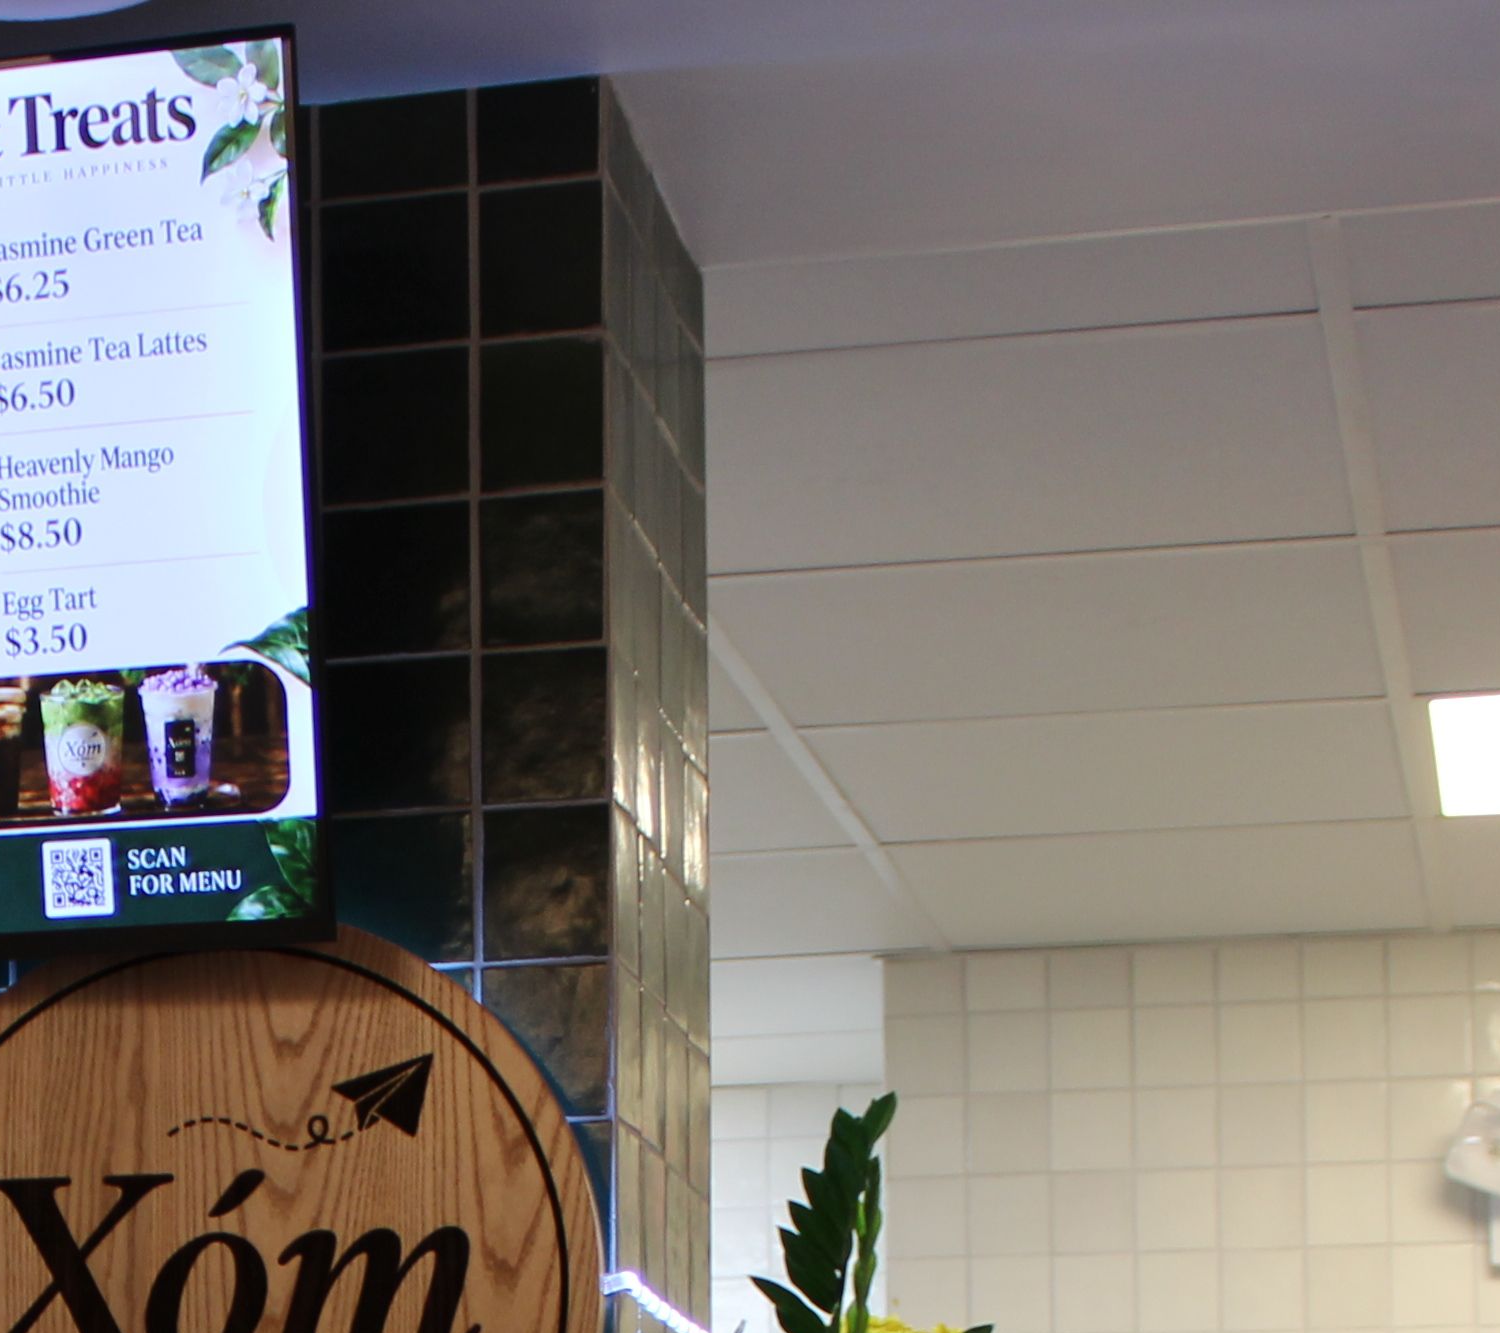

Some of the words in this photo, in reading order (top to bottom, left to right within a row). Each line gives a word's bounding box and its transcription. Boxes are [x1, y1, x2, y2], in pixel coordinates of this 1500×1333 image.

[8, 88, 197, 155] Treats
[64, 158, 168, 180] HAPPINESS
[84, 226, 154, 253] Green
[160, 221, 203, 243] Tea
[89, 337, 132, 362] Tea
[137, 330, 207, 356] Lattes
[99, 446, 174, 473] Mango
[0, 518, 82, 553] $8.50
[2, 592, 44, 620] Egg
[48, 587, 97, 614] Tart
[5, 623, 87, 657] $3.50
[128, 848, 186, 869] SCAN
[130, 874, 174, 896] FOR
[180, 870, 242, 893] MENU
